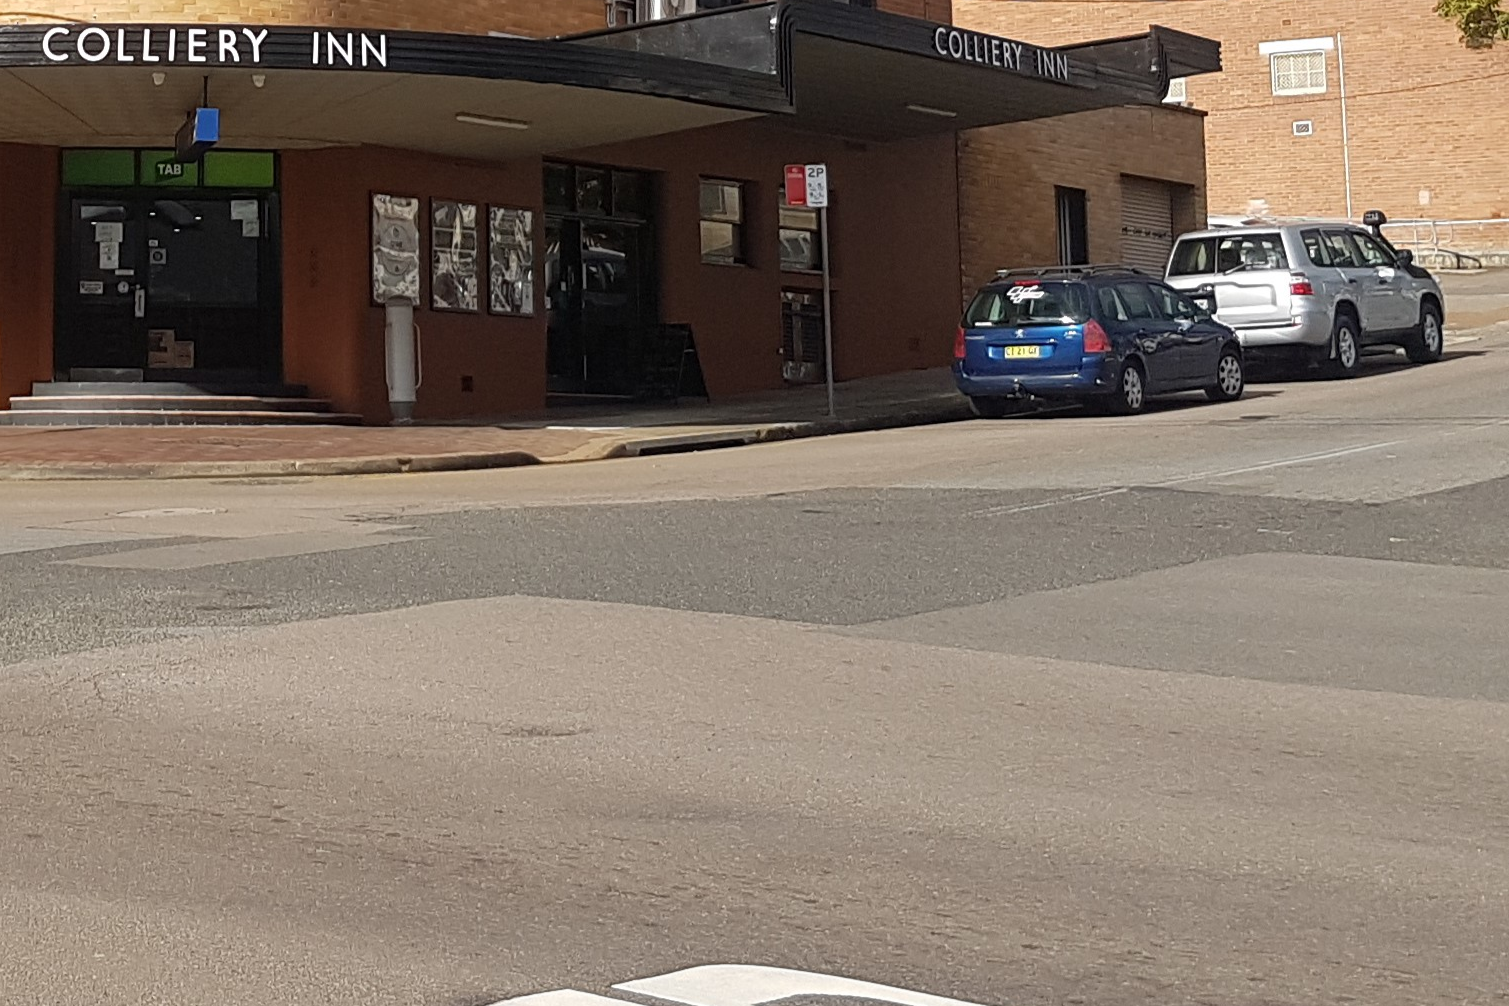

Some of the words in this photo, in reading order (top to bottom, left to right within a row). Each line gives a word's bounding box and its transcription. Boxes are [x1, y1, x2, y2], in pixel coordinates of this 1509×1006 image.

[42, 27, 268, 63] COLLIERY
[312, 30, 388, 68] INN
[935, 27, 1022, 71] COLLIERY
[1036, 48, 1068, 81] INN
[157, 163, 182, 175] TAB
[807, 167, 824, 178] 2P
